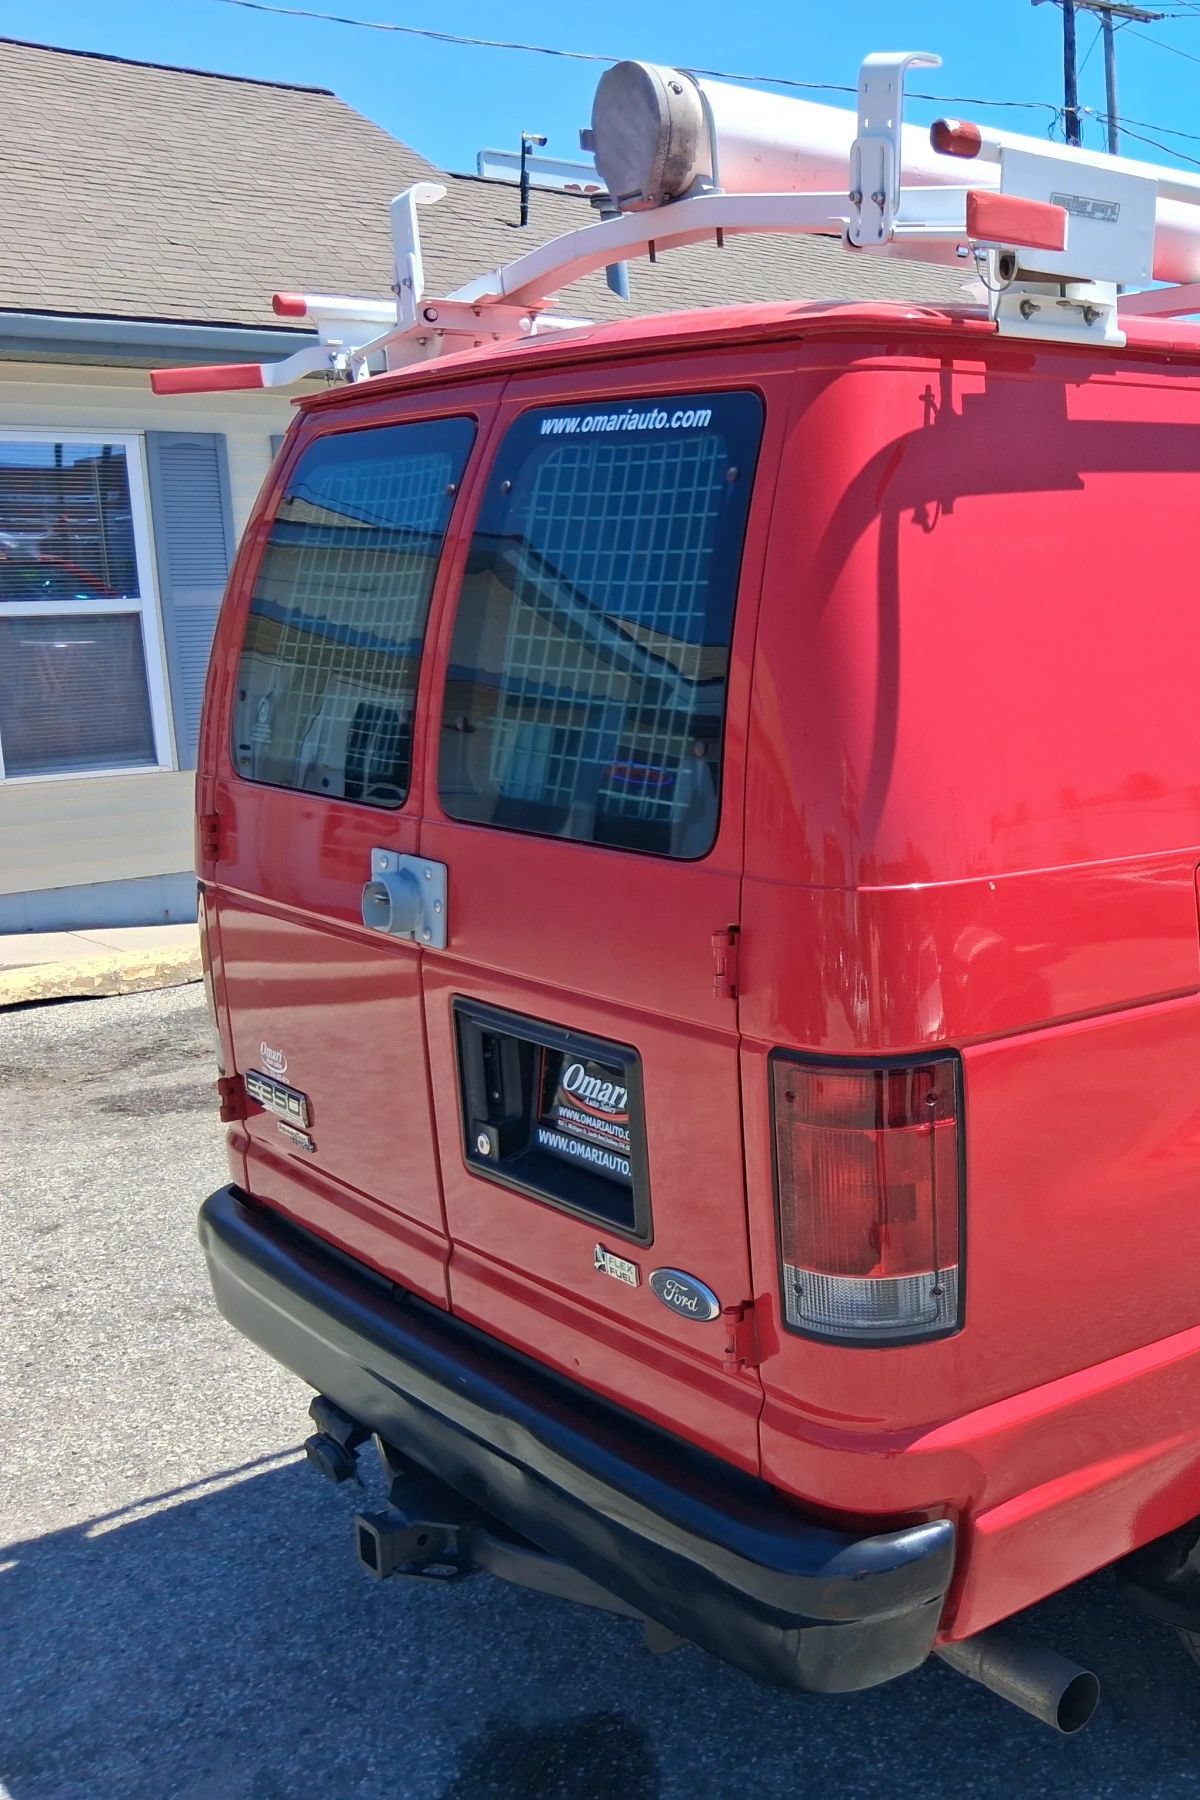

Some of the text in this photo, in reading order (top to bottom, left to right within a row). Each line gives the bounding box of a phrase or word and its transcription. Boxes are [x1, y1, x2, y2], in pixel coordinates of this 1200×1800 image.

[540, 408, 712, 435] www.omariauto.com
[260, 1041, 283, 1063] Omari
[584, 1096, 617, 1114] Auto Sales
[538, 1129, 632, 1177] WWW.OMARIAUTO.
[608, 1257, 633, 1272] FLEX
[609, 1268, 635, 1284] FUEL
[664, 1279, 698, 1312] Ford
